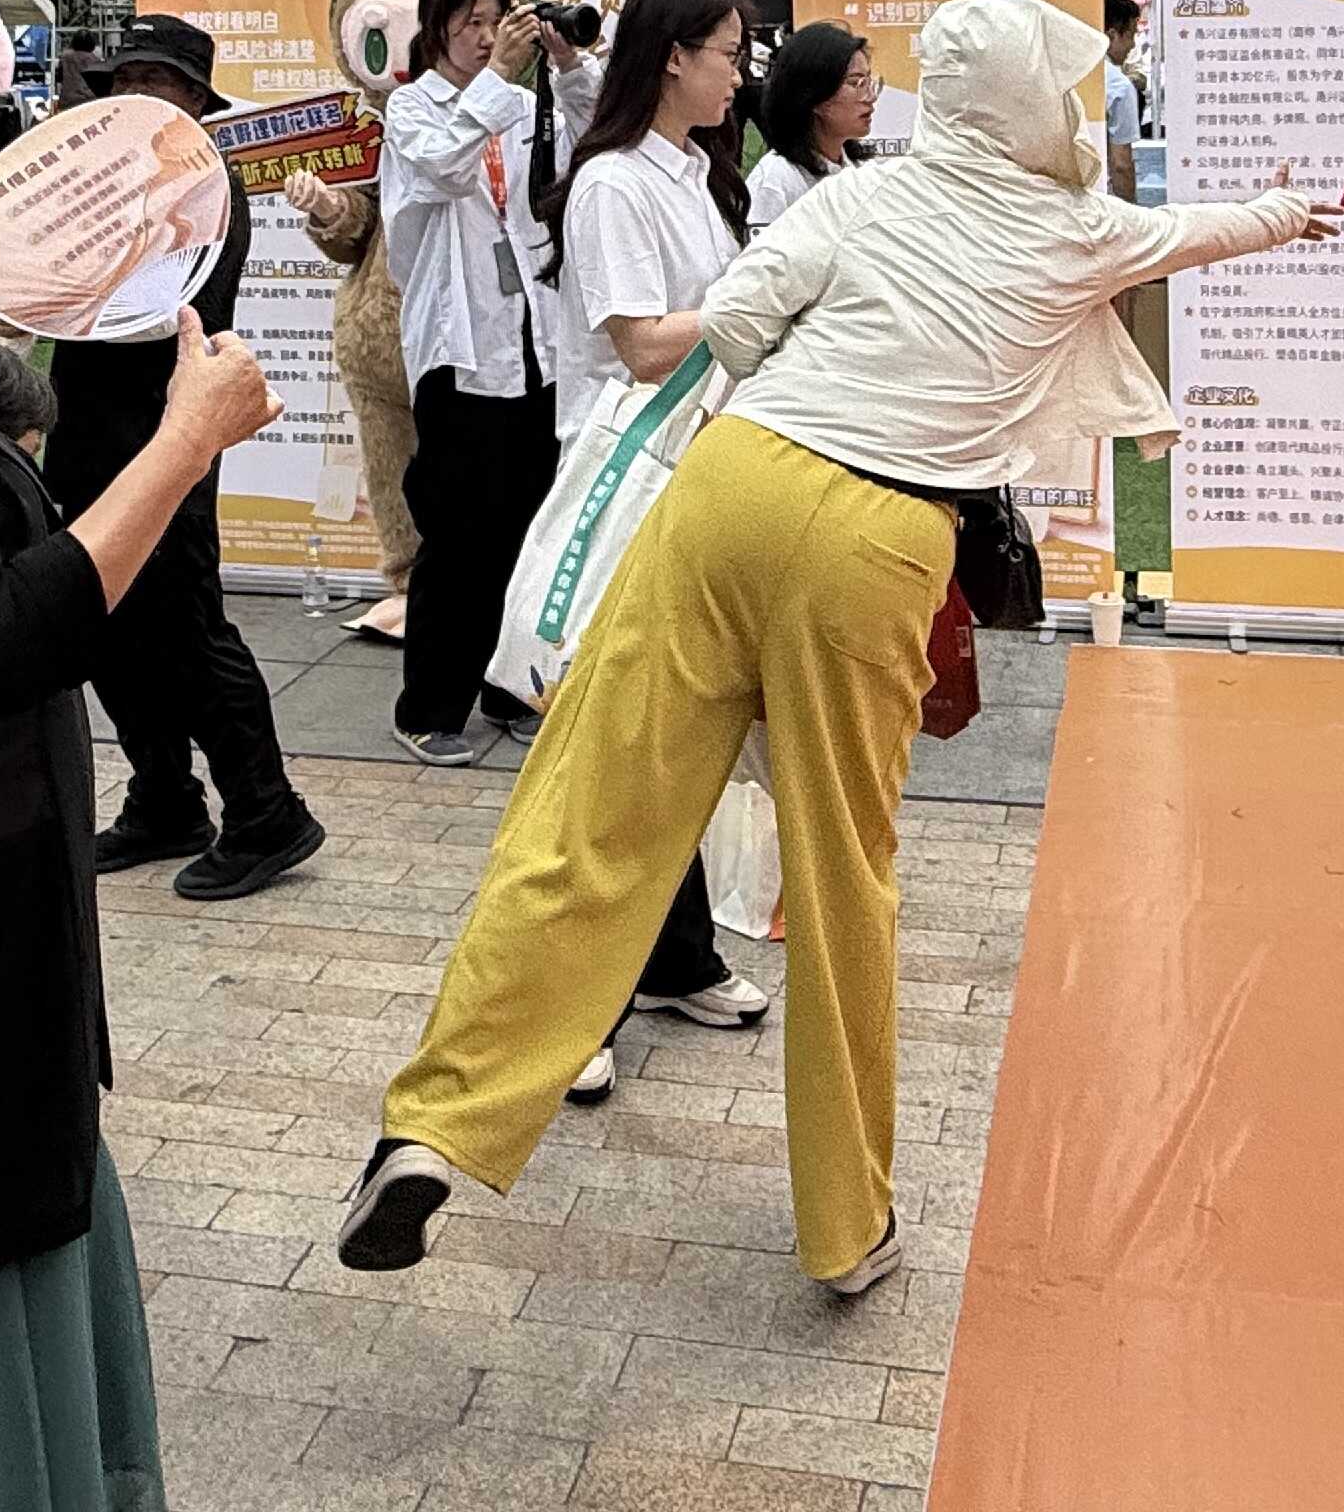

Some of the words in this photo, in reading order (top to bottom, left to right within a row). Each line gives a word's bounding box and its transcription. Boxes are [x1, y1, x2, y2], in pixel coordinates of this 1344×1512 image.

[216, 101, 343, 149] 虚假理财花样多
[1188, 385, 1256, 406] 企业文化
